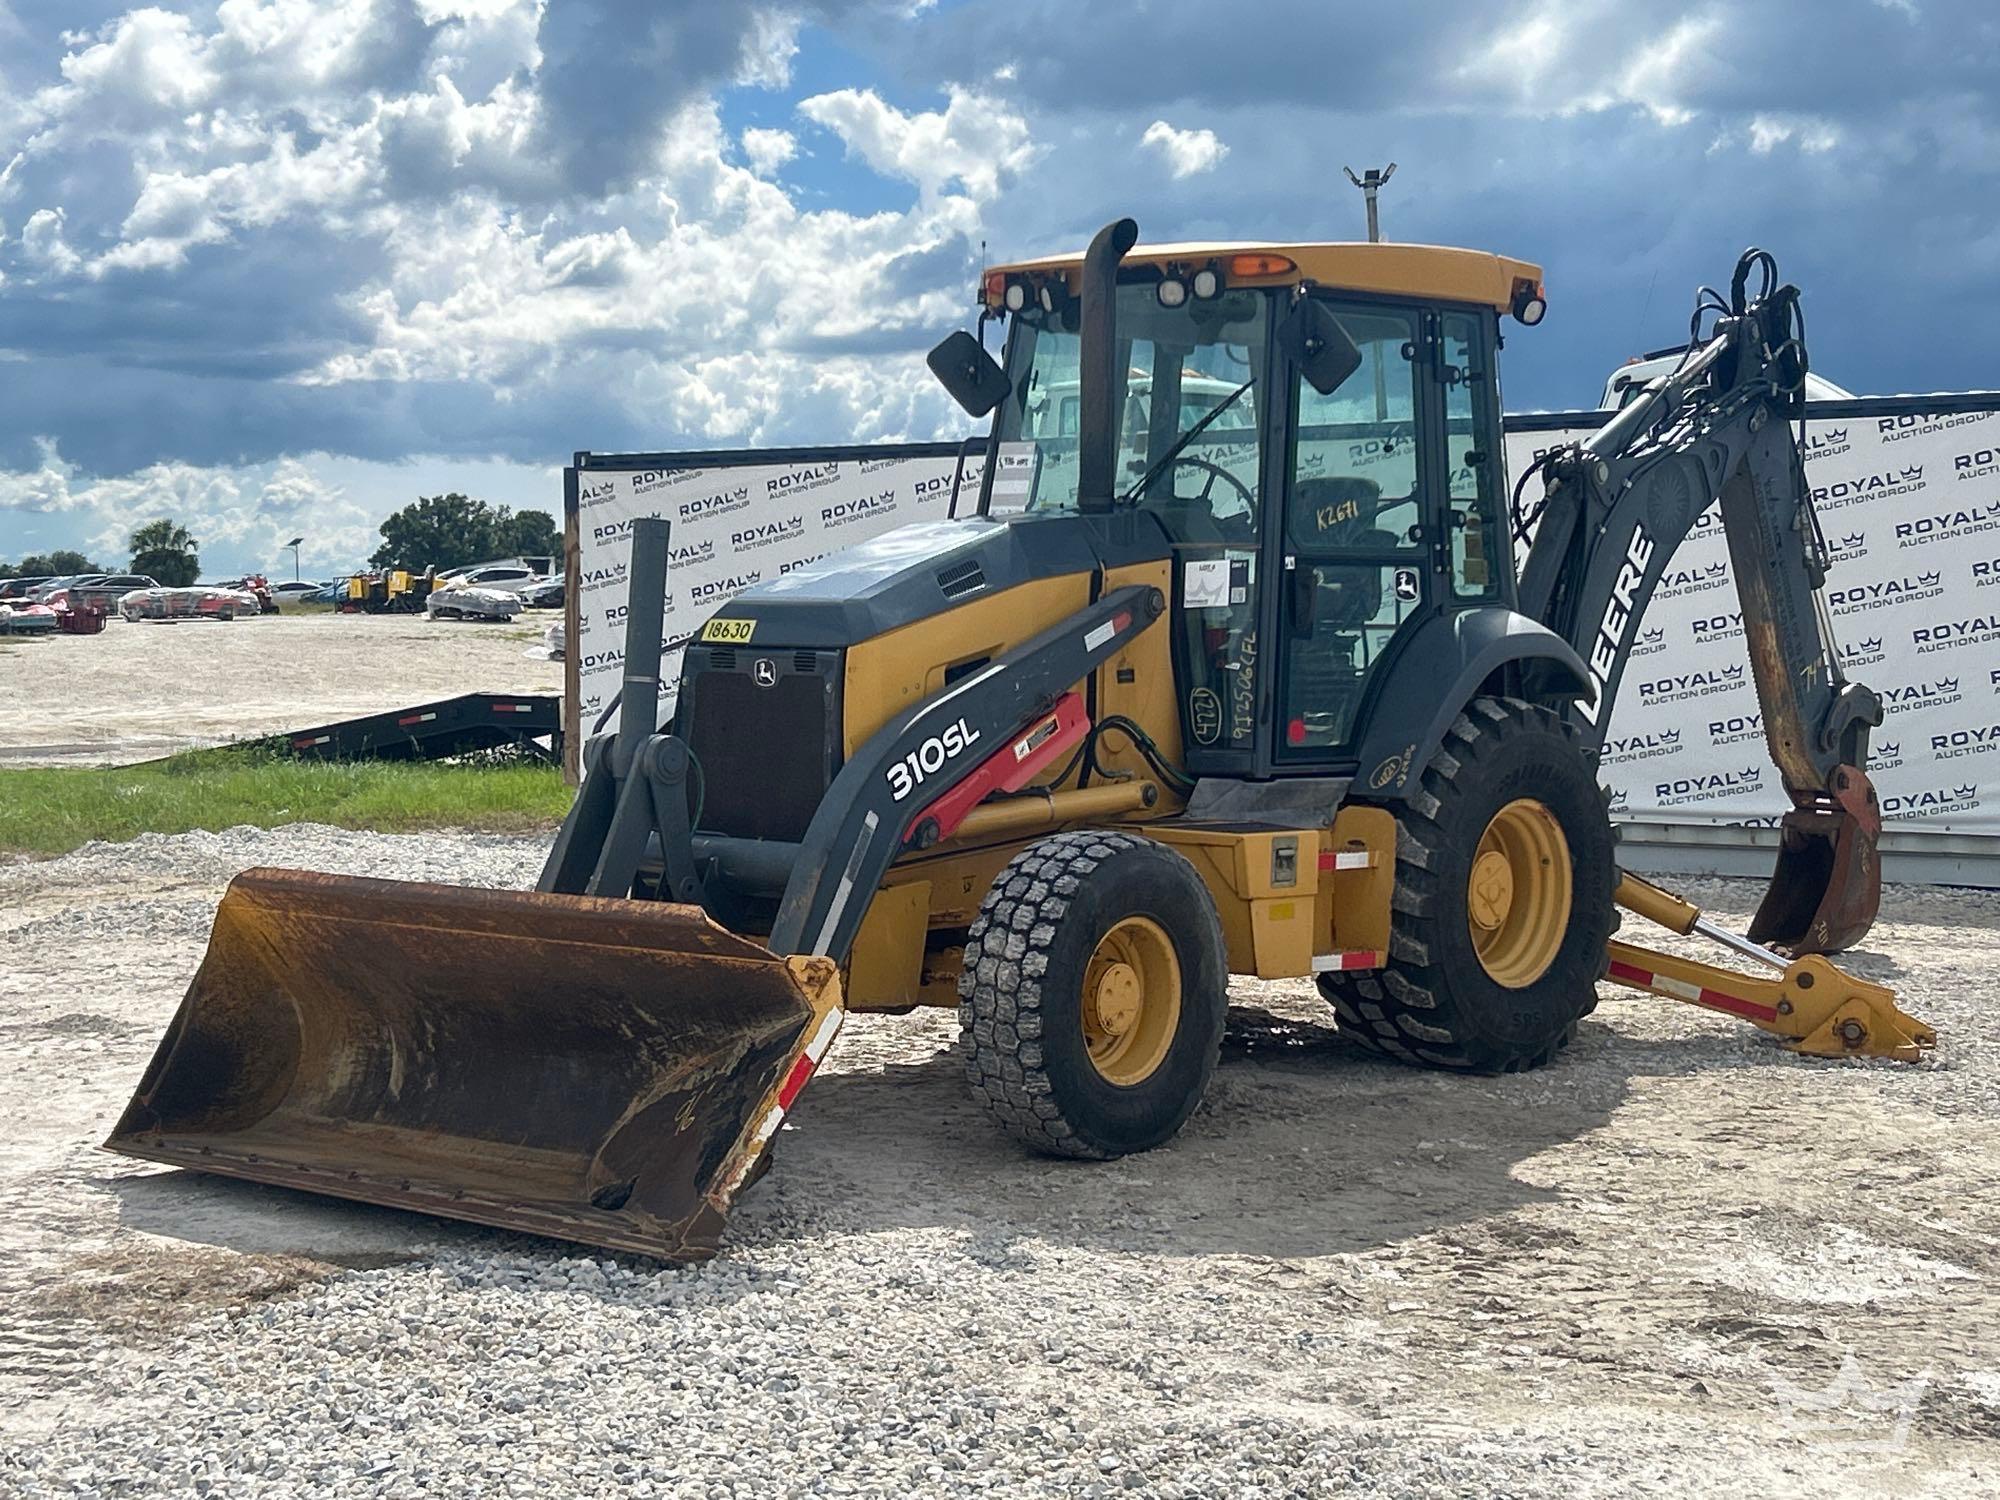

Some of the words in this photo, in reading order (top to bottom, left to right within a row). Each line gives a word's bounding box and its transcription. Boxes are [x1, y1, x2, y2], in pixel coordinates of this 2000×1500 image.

[1881, 422, 1944, 444] AUCTION
[767, 467, 824, 492] ROYAL
[1957, 464, 2000, 482] AUCTI
[1811, 472, 1901, 502] ROYAL
[1815, 492, 1875, 513] AUCTION
[1877, 481, 1926, 499] GROUP
[679, 493, 734, 517] ROYAL
[821, 496, 880, 521] ROYAL
[1316, 499, 1359, 532] K2671
[681, 508, 719, 525] AUCTION
[823, 512, 864, 529] AUCTION
[1895, 508, 1987, 539] ROYAL
[594, 519, 635, 539] ROYA
[731, 522, 788, 545] ROYAL
[1898, 528, 1961, 549] AUCTION
[668, 545, 700, 561] YAL
[733, 536, 772, 553] AUCTION
[1829, 548, 1868, 564] ROUP
[691, 575, 747, 599] ROYAL
[1660, 569, 1705, 589] YAL
[1683, 578, 1729, 594] GROUP
[1828, 578, 1919, 607] ROYAL
[1831, 598, 1894, 617] AUCTION
[1895, 587, 1944, 604] GROUP
[707, 621, 751, 639] 18630
[1574, 523, 1655, 726] DEERE
[1691, 612, 1743, 634] ROY
[1695, 628, 1743, 645] AUCTIO
[1916, 636, 1979, 655] AUCTION
[1631, 643, 1666, 657] ROUP
[1639, 670, 1722, 697] ROYAL
[1641, 690, 1699, 708] AUCTION
[1699, 680, 1747, 697] GROUP
[1912, 693, 1963, 711] GROUP
[1708, 714, 1760, 736] ROY
[1600, 734, 1660, 756] OYAL
[1931, 726, 2000, 750] ROYA
[886, 718, 981, 801] 310SL
[1599, 752, 1637, 767] CTION
[1638, 744, 1684, 760] GROUP
[1934, 743, 1997, 761] AUCTION
[1655, 772, 1739, 798] ROYAL
[1657, 790, 1716, 808] AUCTION
[1717, 782, 1764, 798] GROUP
[1882, 789, 1954, 812] OYAL
[1929, 800, 1980, 817] GROUP
